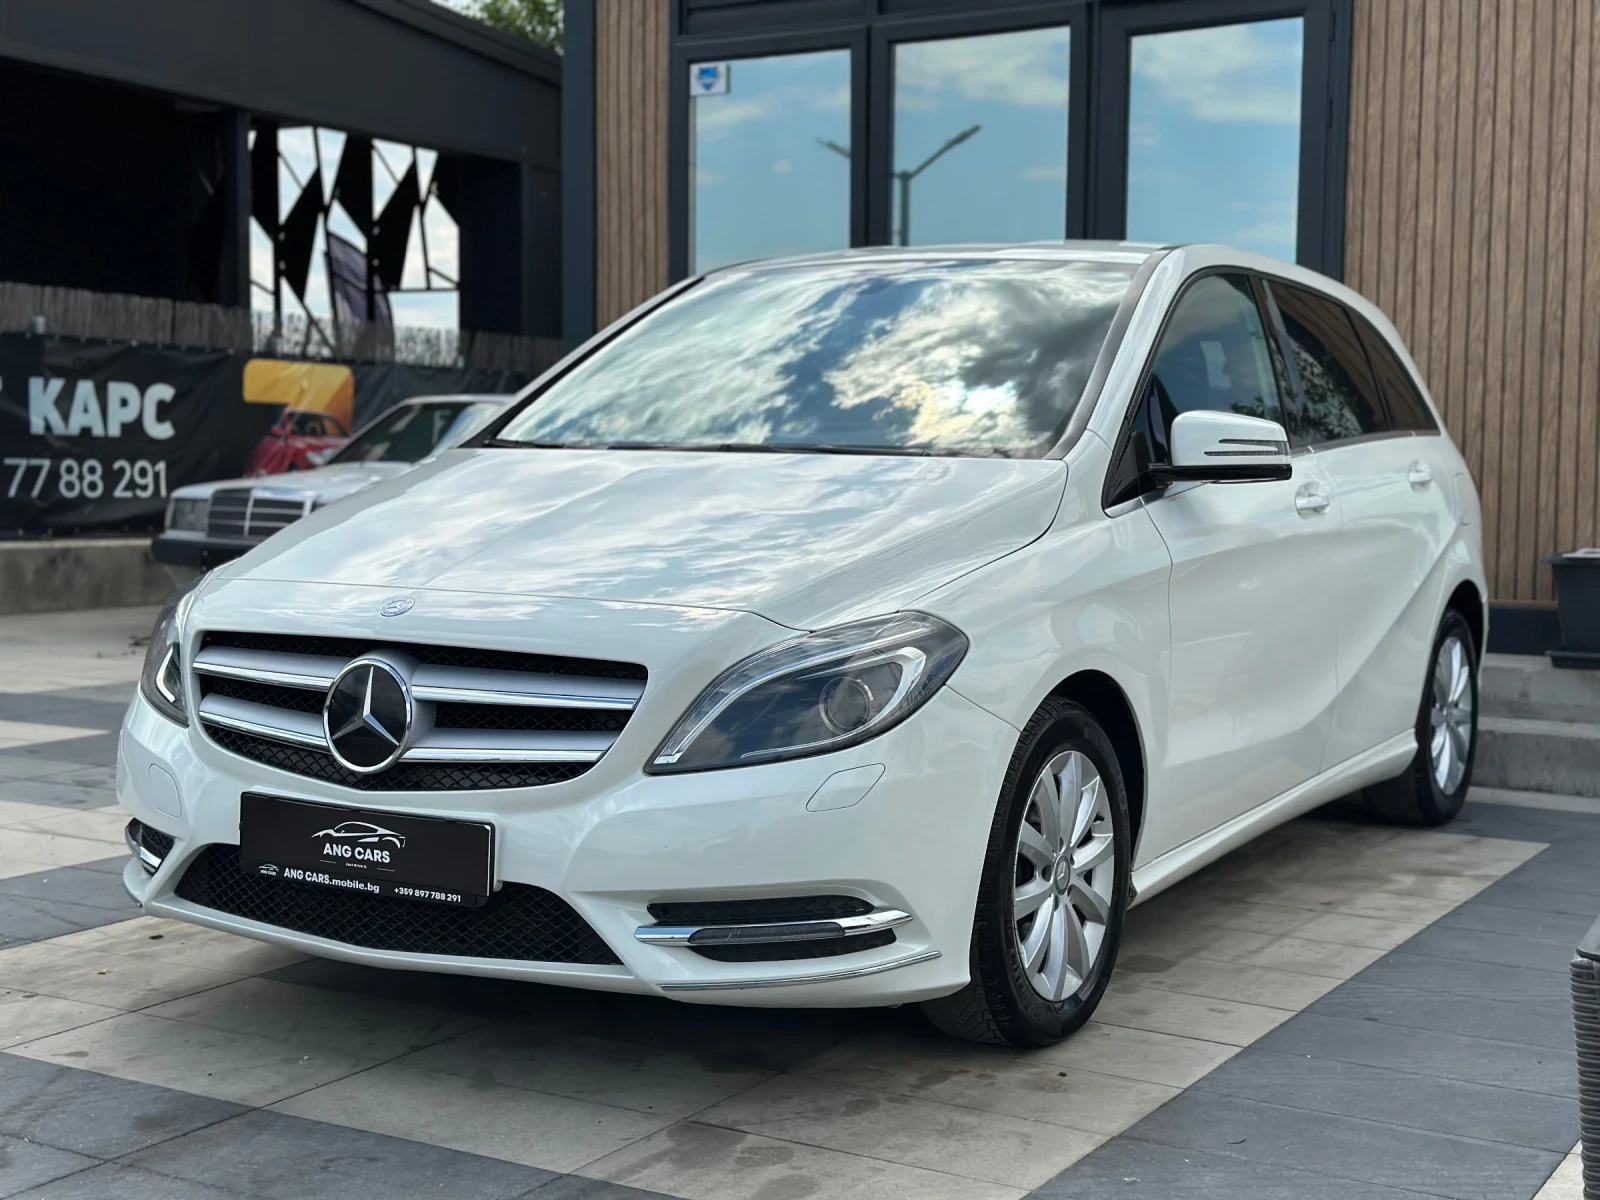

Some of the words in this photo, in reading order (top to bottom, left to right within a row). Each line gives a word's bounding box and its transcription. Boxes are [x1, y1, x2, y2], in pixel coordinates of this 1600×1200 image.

[28, 376, 176, 440] КАРС
[3, 457, 51, 499] 77
[59, 458, 104, 499] 88
[112, 459, 168, 499] 291
[323, 843, 352, 858] ANG
[354, 847, 391, 864] CARS
[283, 867, 304, 880] ANG
[305, 871, 380, 894] CARS.mobile.bg
[393, 886, 414, 896] +359
[414, 889, 430, 898] 897
[430, 891, 446, 901] 788
[446, 893, 461, 903] 291
